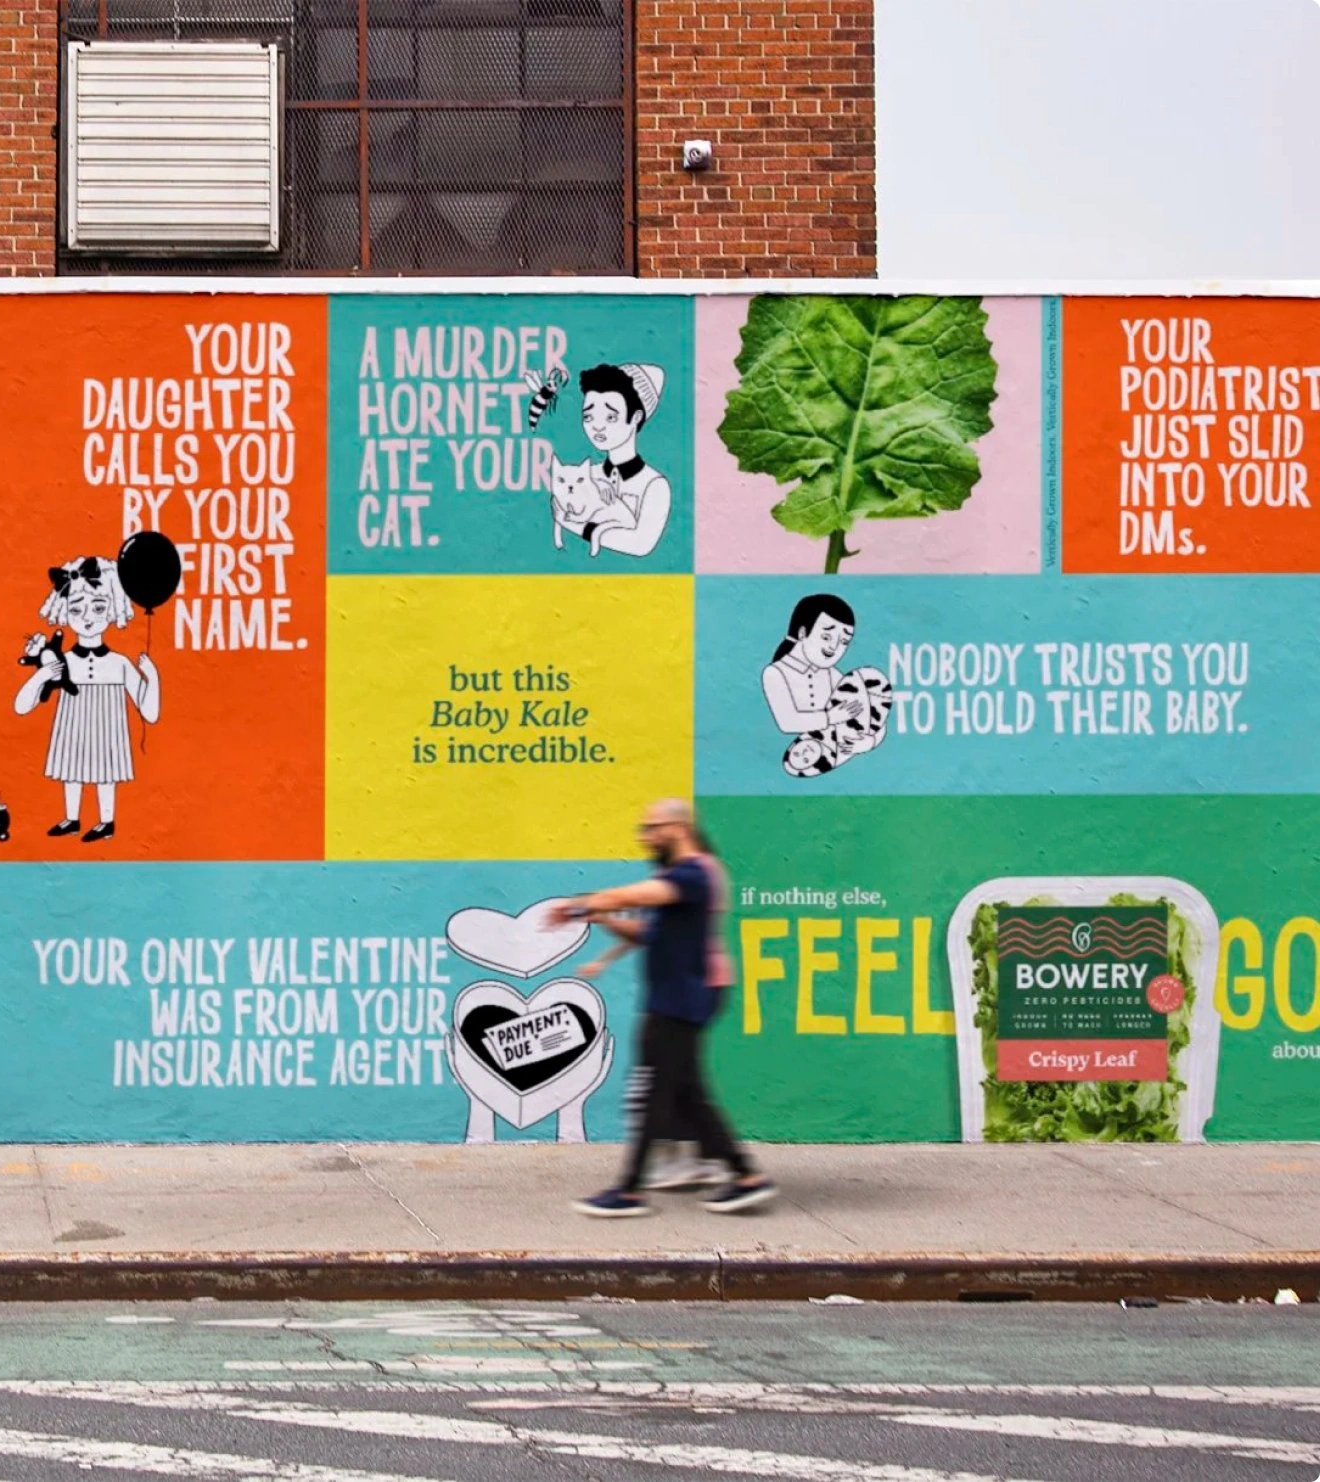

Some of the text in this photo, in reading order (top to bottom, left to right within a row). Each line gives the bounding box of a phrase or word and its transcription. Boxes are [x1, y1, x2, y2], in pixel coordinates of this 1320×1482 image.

[185, 322, 294, 377] YOUR
[359, 325, 569, 380] A MURDER
[1046, 343, 1056, 380] Grown
[1121, 318, 1214, 365] YOUR
[83, 376, 294, 431] DAUGHTER
[358, 381, 532, 437] HORNET
[1120, 364, 1320, 413] PODIATRIST
[84, 432, 295, 486] CALLS YOU
[1121, 413, 1303, 460] JUST SLID
[359, 437, 553, 492] ATE YOUR
[1120, 460, 1310, 508] INTO YOUR
[122, 486, 293, 542] BY YOUR
[358, 494, 440, 547] CAT.
[1046, 478, 1056, 516] Grown
[1045, 518, 1057, 568] Vertically
[1120, 509, 1206, 555] DMs.
[175, 542, 294, 597] FIRST
[175, 597, 308, 650] NAME.
[449, 664, 570, 692] but this
[888, 642, 1248, 688] NOBODY TRUSTS YOU
[430, 700, 589, 734] Baby Kale
[891, 689, 1247, 735] TO HOLD THEIR BABY.
[413, 736, 615, 763] is incredible.
[740, 887, 886, 909] if nothing else,
[33, 937, 451, 986] YOUR ONLY VALENTINE
[739, 916, 956, 1035] FEEL
[1017, 964, 1149, 988] BOWERY
[1214, 916, 1320, 1033] GO
[150, 987, 449, 1036] WAS FROM YOUR
[496, 1011, 562, 1046] PAYMENT
[114, 1038, 316, 1087] INSURANCE
[504, 1041, 533, 1062] DUE
[1029, 1050, 1137, 1071] Crispy Leaf
